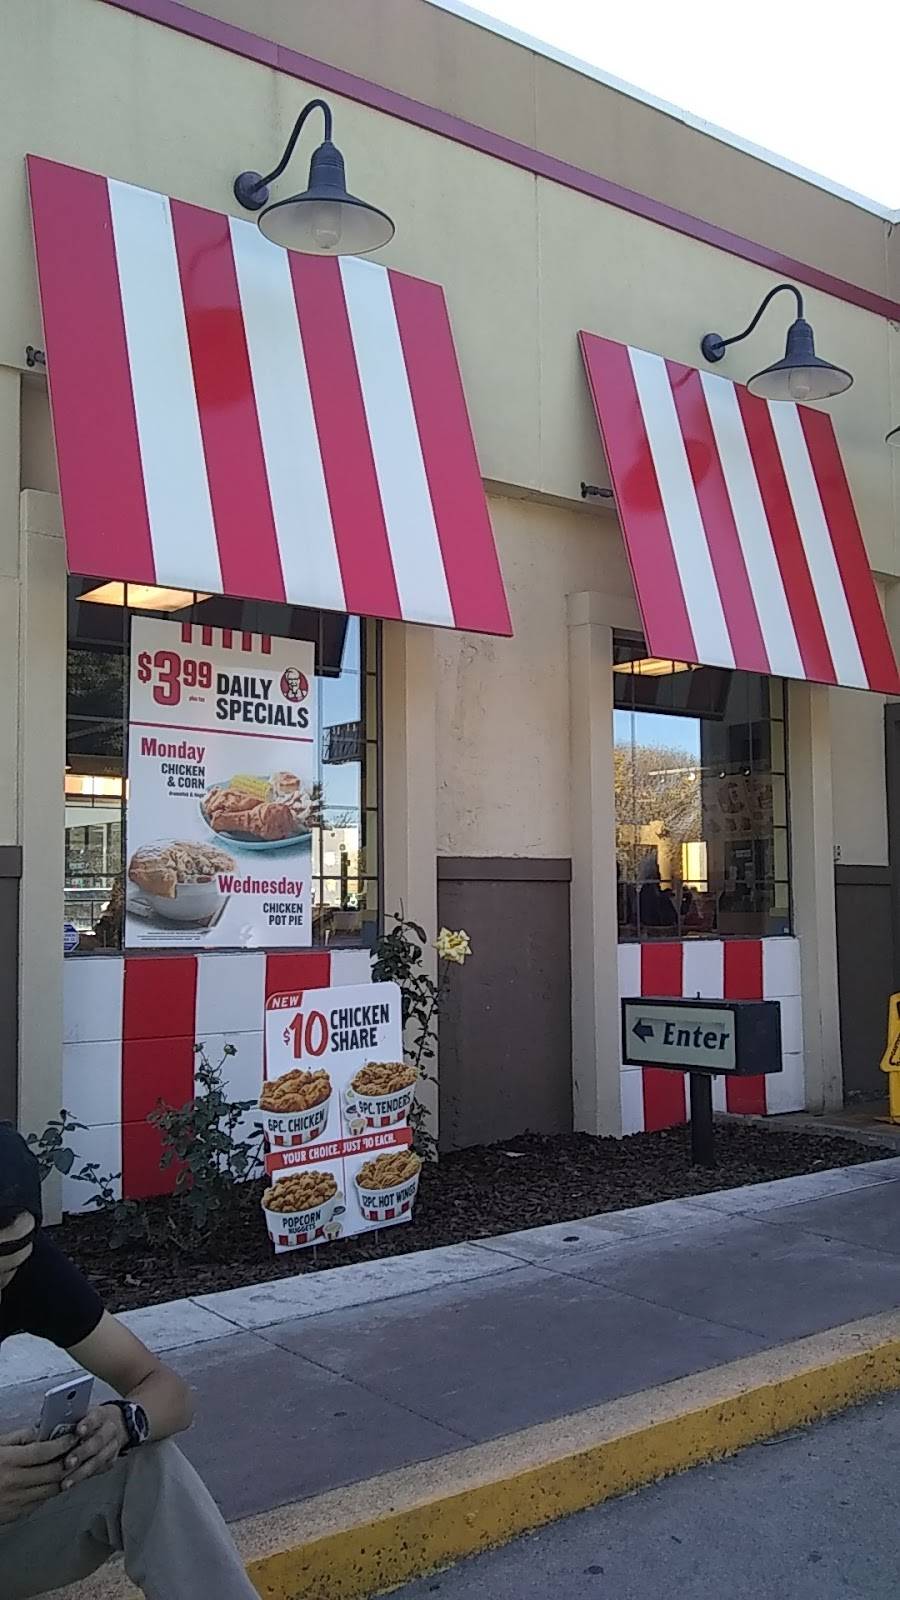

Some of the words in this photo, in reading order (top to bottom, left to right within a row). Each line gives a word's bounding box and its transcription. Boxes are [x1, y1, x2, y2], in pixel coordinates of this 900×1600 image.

[216, 673, 273, 701] DAILY
[215, 697, 309, 729] SPECIALS
[141, 737, 206, 763] Monday
[161, 763, 205, 777] CHICKEN
[167, 776, 175, 787] &
[178, 776, 205, 789] CORN
[218, 875, 303, 898] Wednesday
[263, 903, 303, 914] CHICKEN
[268, 915, 286, 926] POT
[288, 916, 303, 926] PIE
[271, 995, 299, 1009] NEW
[330, 1003, 390, 1030] CHICKEN
[283, 1010, 329, 1059] $10
[331, 1027, 378, 1052] SHARE
[663, 1022, 730, 1050] Enter
[376, 1091, 411, 1114] TENDERS
[287, 1108, 325, 1132] CHICKEN
[282, 1150, 307, 1165] YOUR
[308, 1144, 341, 1160] CHOICE.
[341, 1139, 361, 1154] JUST
[374, 1133, 396, 1147] EACH.
[378, 1193, 394, 1208] HOT
[395, 1181, 416, 1203] WINGS
[282, 1210, 321, 1228] POPCORN
[288, 1223, 316, 1234] NUGGETS
